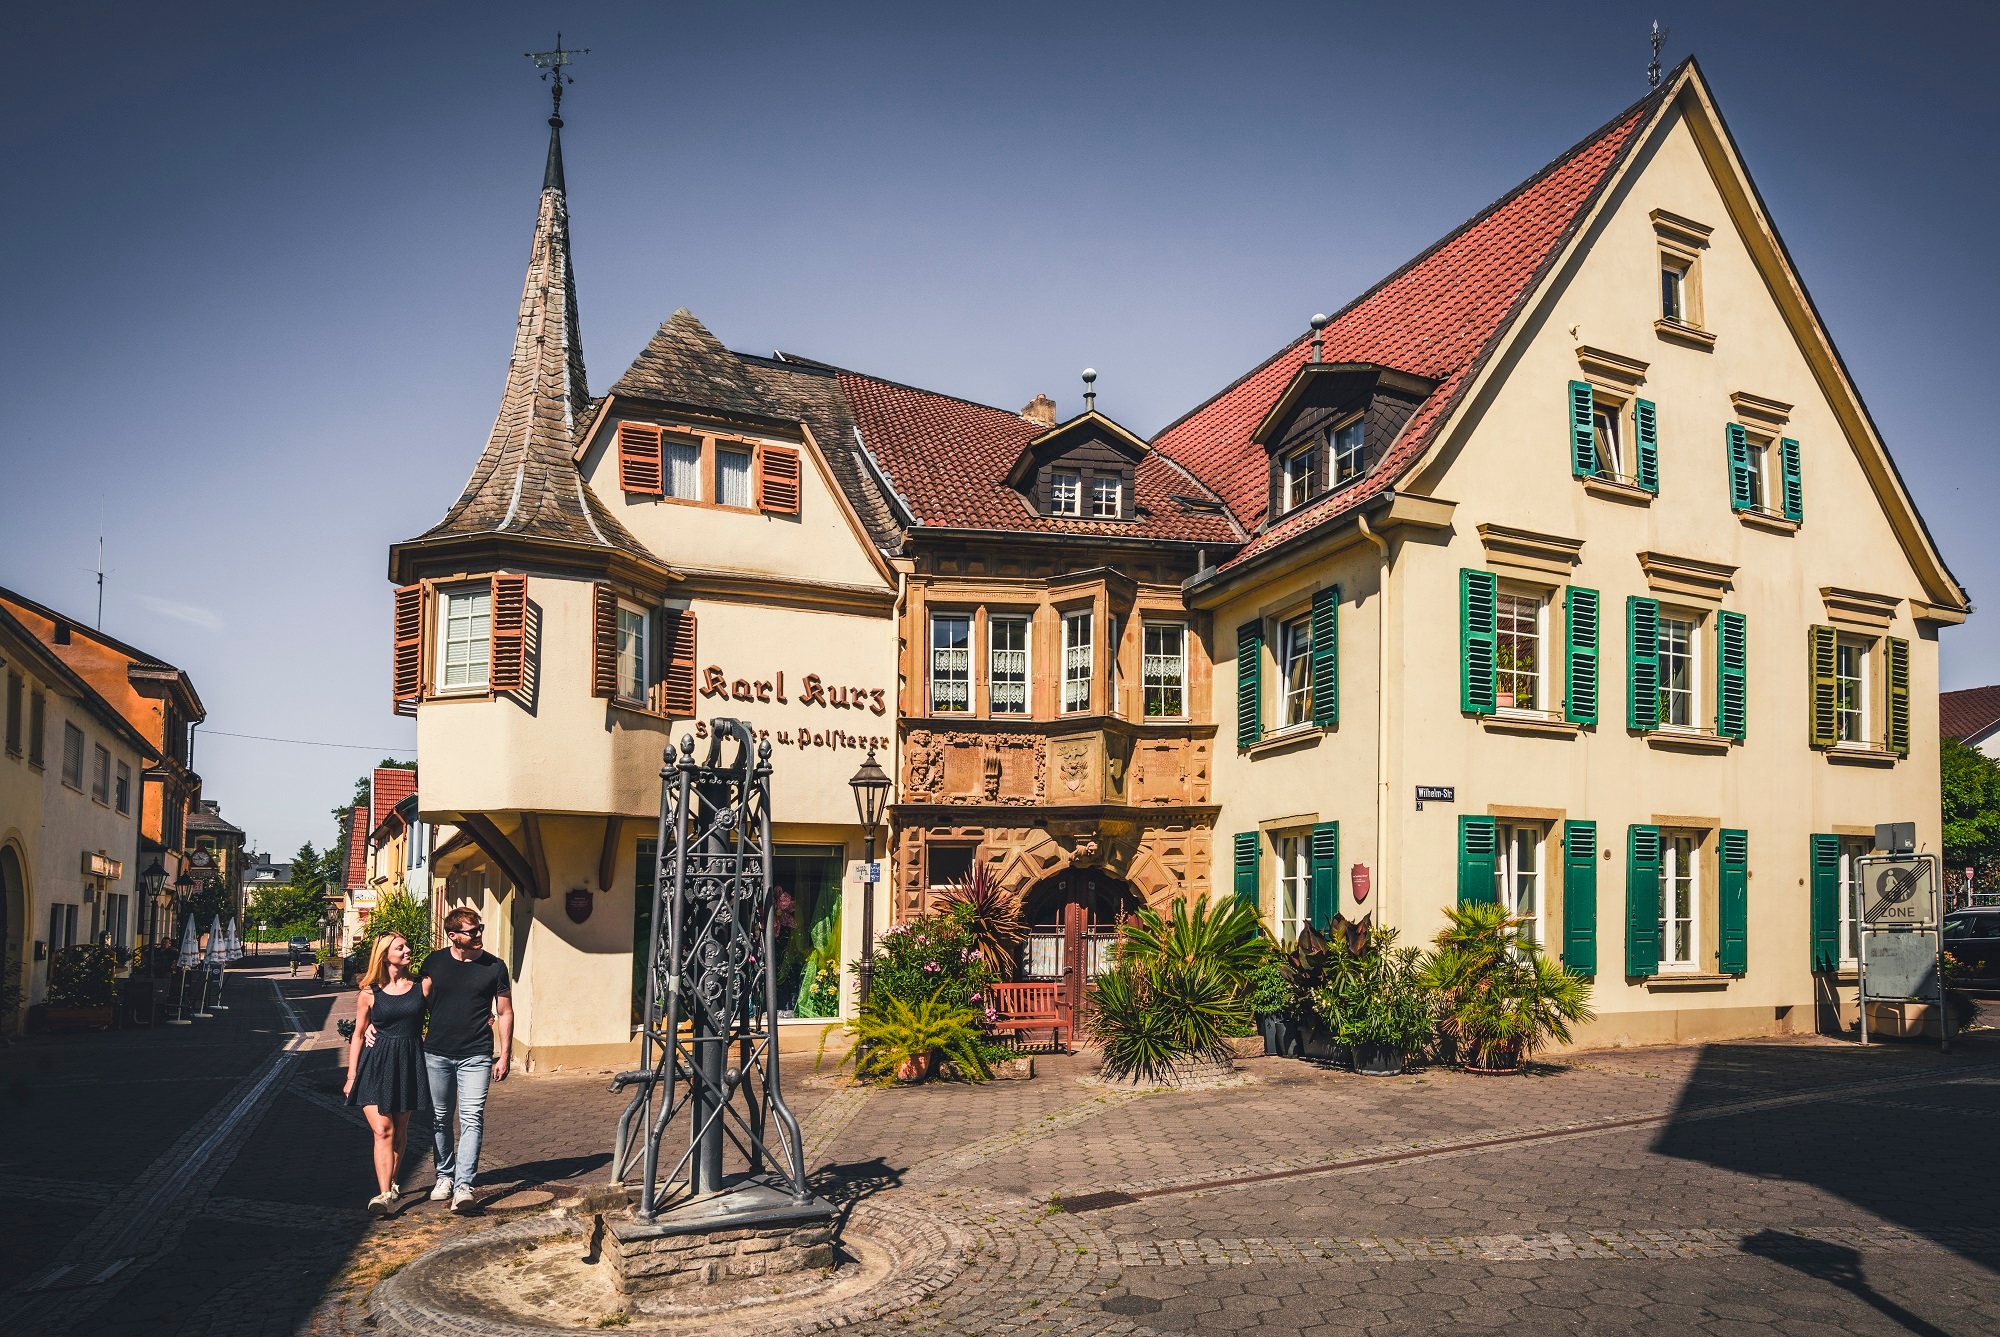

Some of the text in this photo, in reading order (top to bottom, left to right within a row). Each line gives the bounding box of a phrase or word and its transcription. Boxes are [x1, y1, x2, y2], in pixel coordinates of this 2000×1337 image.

[700, 665, 885, 715] Karl Kurz
[1881, 907, 1915, 918] ZONE
